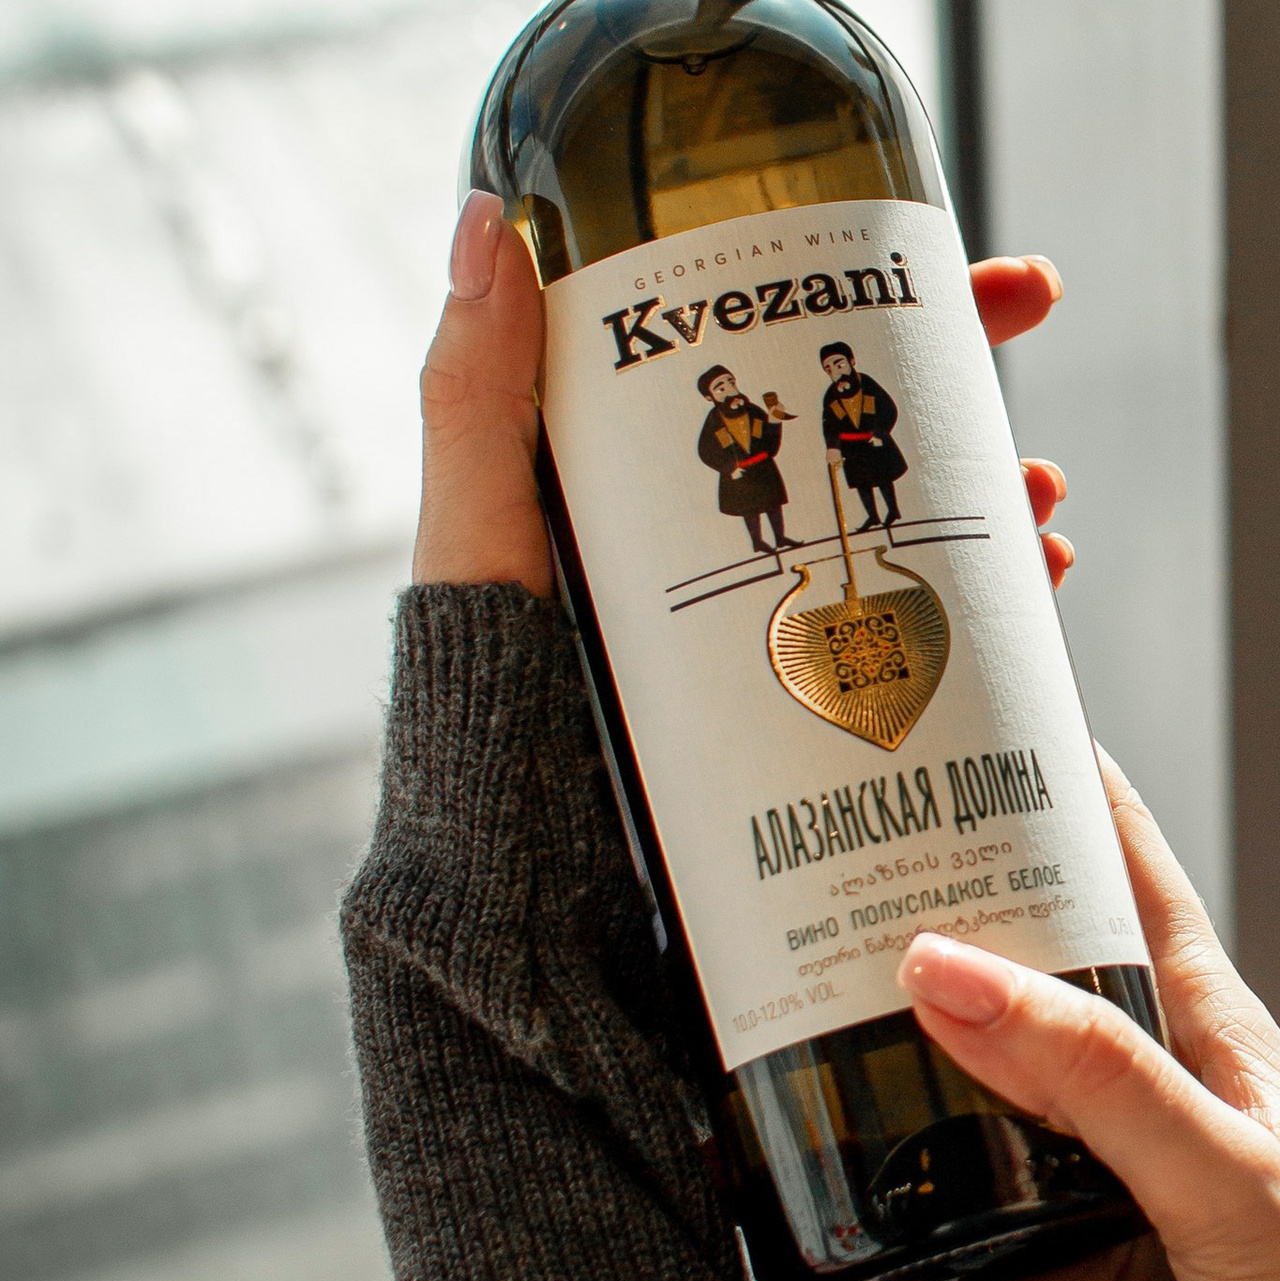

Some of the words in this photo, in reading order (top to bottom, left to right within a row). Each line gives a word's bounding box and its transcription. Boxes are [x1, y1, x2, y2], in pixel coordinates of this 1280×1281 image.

[633, 239, 786, 290] GEORGIAN
[805, 227, 873, 246] WINE
[602, 251, 923, 375] Kvezani
[750, 765, 942, 880] АЛАЗАНСКАЯ
[945, 748, 1054, 835] ДОЛИНА
[786, 916, 840, 952] ВИНО
[850, 874, 999, 930] ПОЛУСЛАДКОЕ
[1008, 863, 1066, 892] БЕЛОЕ
[828, 852, 940, 897] ალაზნის
[950, 840, 1013, 870] ველი
